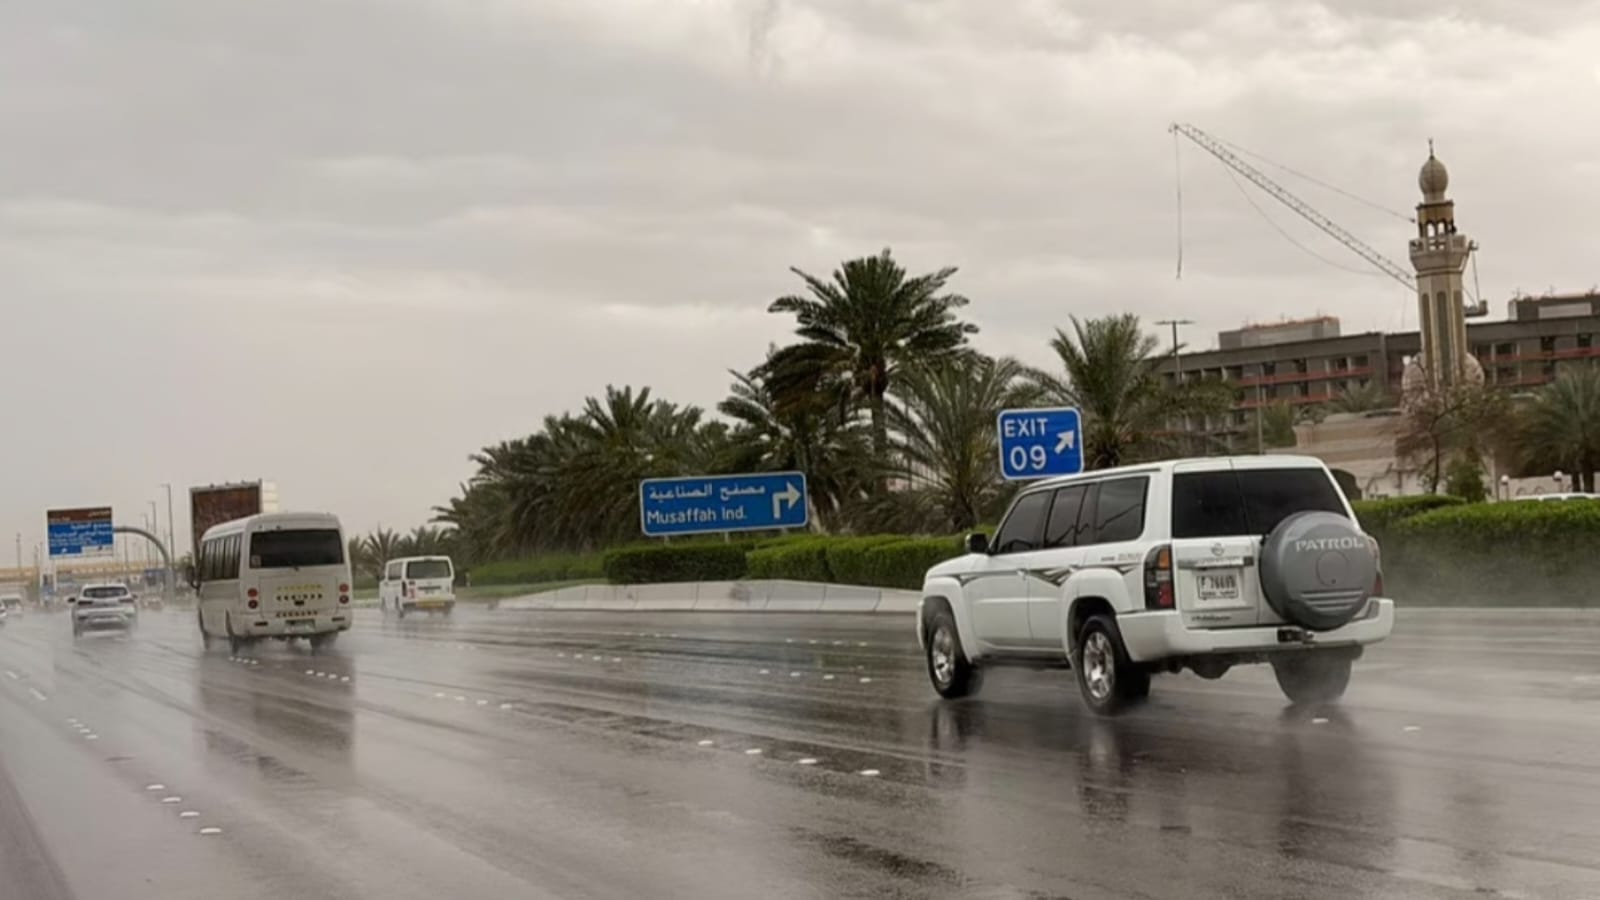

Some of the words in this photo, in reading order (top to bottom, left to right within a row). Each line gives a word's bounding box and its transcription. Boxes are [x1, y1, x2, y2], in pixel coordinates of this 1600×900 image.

[1004, 418, 1048, 438] EXIT
[1010, 444, 1047, 471] 09
[649, 483, 713, 503] الصناعية
[720, 482, 765, 501] مصفح
[647, 507, 717, 524] Musaffah
[721, 505, 747, 520] Ind.
[1294, 536, 1364, 552] PATROL
